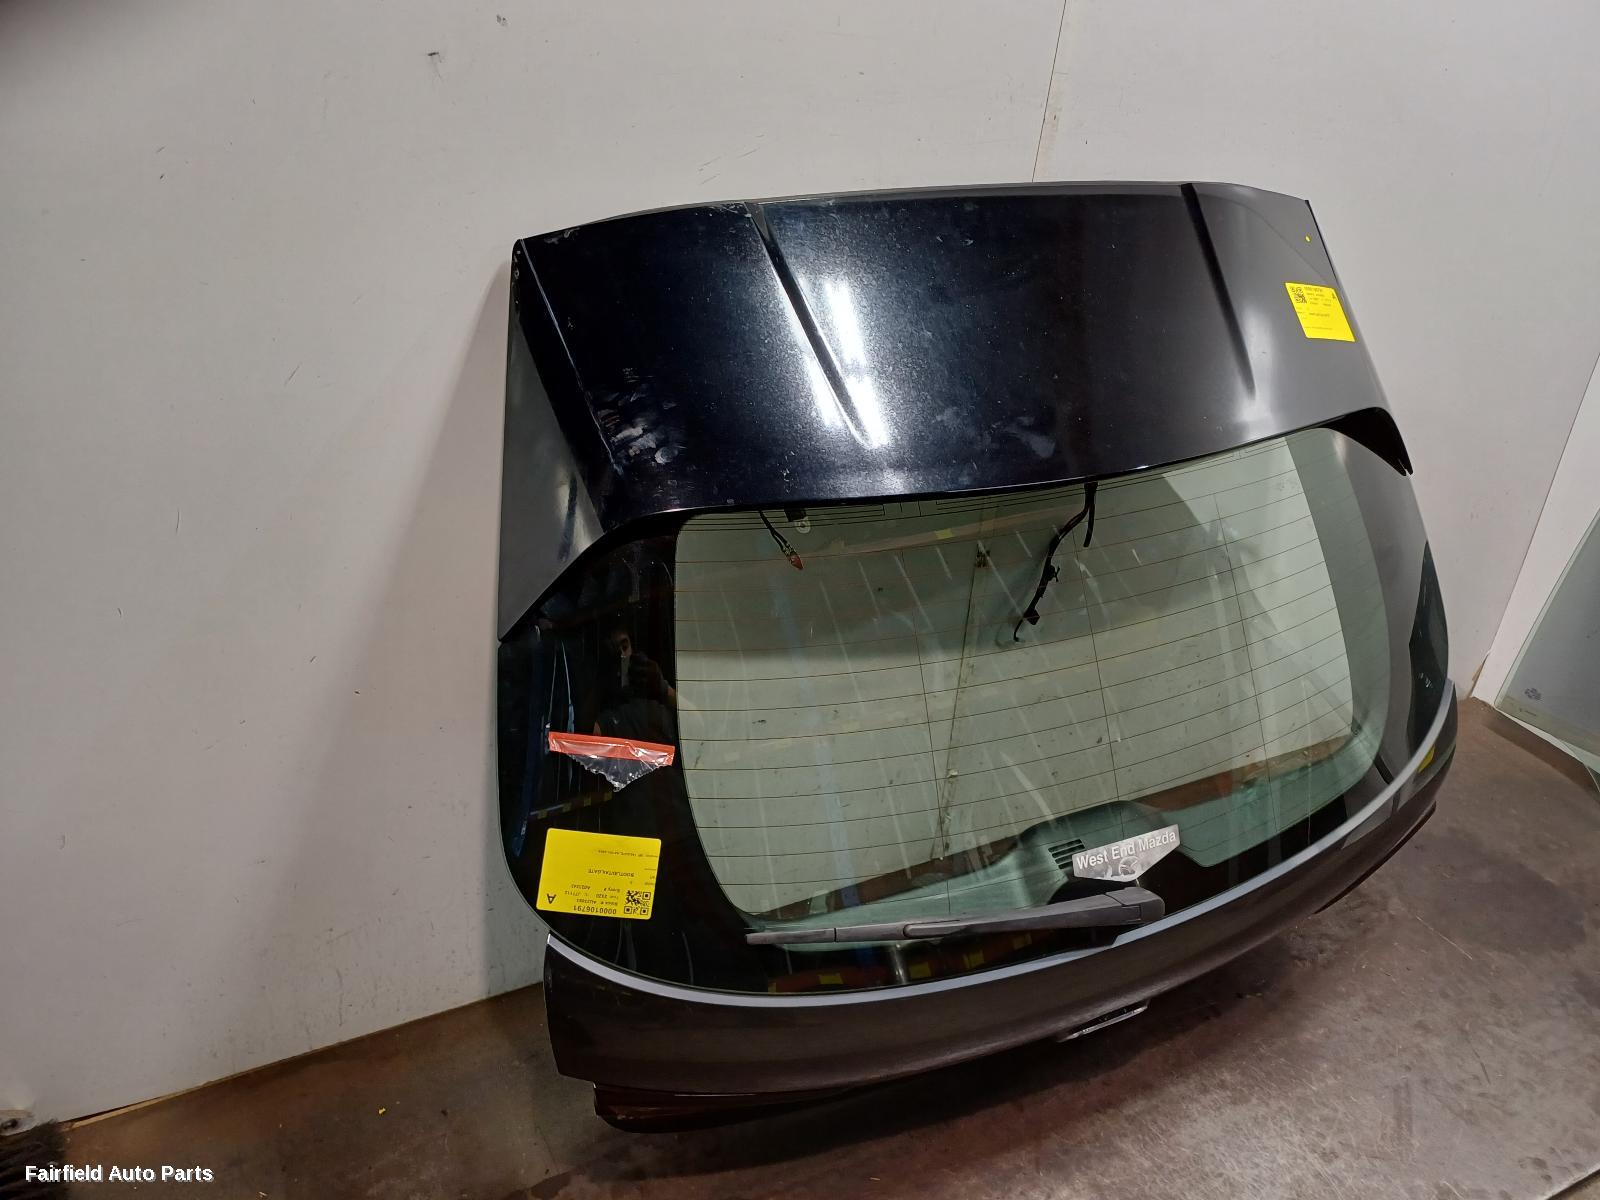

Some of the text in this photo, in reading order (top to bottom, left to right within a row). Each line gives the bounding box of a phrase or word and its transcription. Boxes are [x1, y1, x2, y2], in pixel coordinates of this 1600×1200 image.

[1076, 831, 1177, 869] West End Mazda
[546, 893, 557, 905] A
